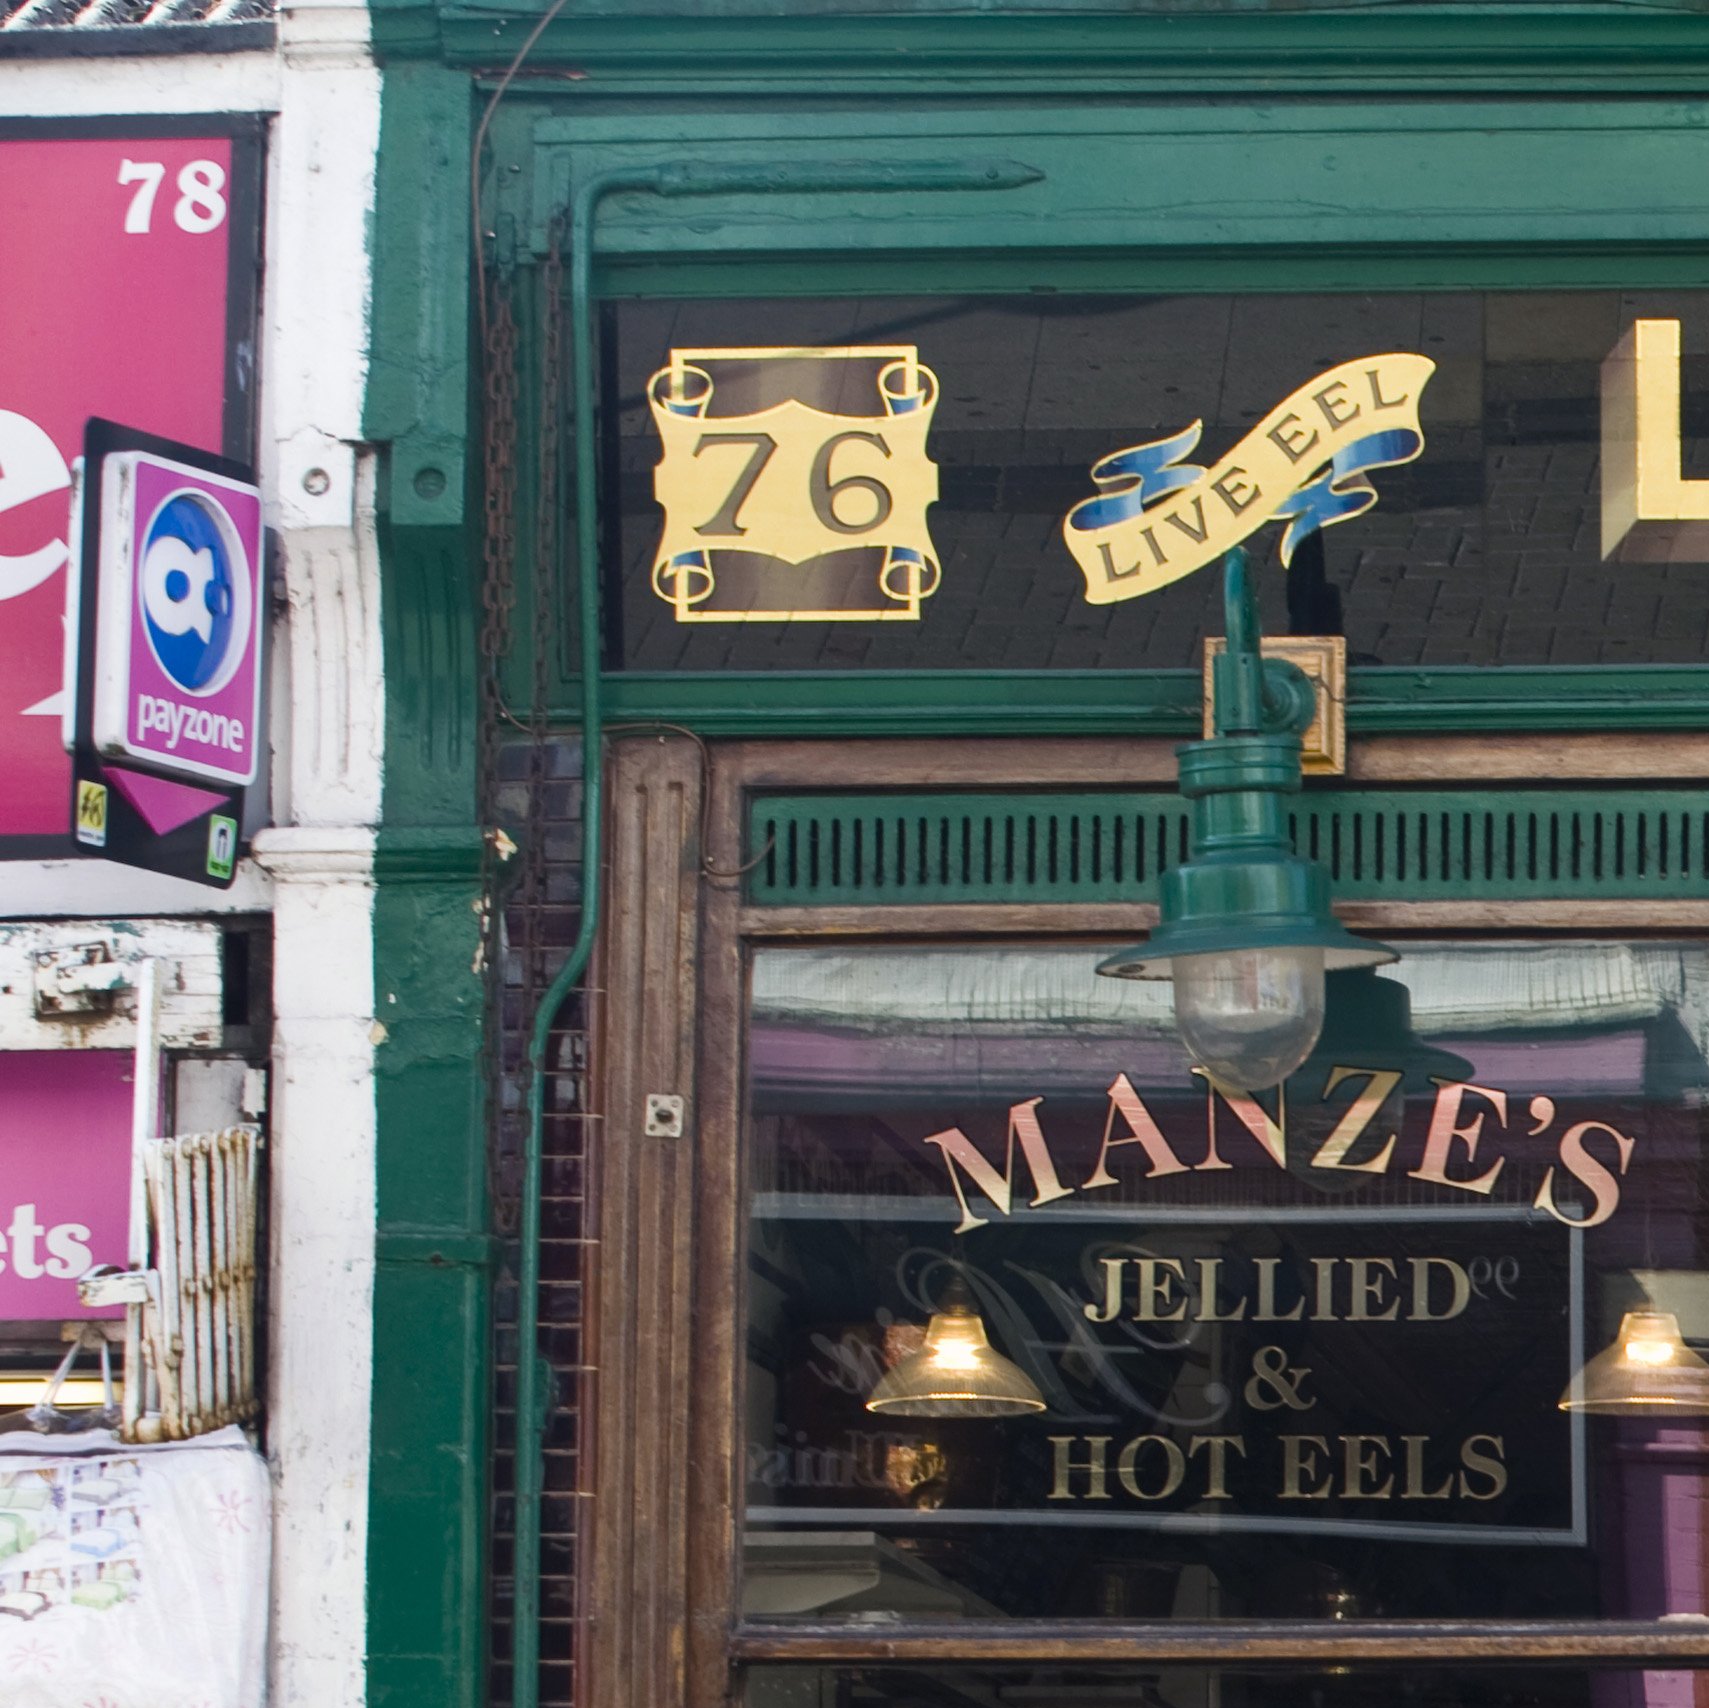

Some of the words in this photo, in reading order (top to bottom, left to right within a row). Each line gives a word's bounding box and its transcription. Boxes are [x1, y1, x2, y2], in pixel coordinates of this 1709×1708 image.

[117, 159, 227, 234] 78
[691, 431, 895, 537] 76
[1096, 466, 1263, 584] LIVE
[1265, 369, 1409, 465] EEL
[138, 694, 244, 754] payzone
[924, 1066, 1636, 1235] MANZE'S
[0, 1202, 93, 1279] ts
[1085, 1257, 1471, 1323] JELLIED
[1245, 1345, 1317, 1410] &
[1047, 1435, 1247, 1499] HOT
[1277, 1433, 1507, 1500] EELS
